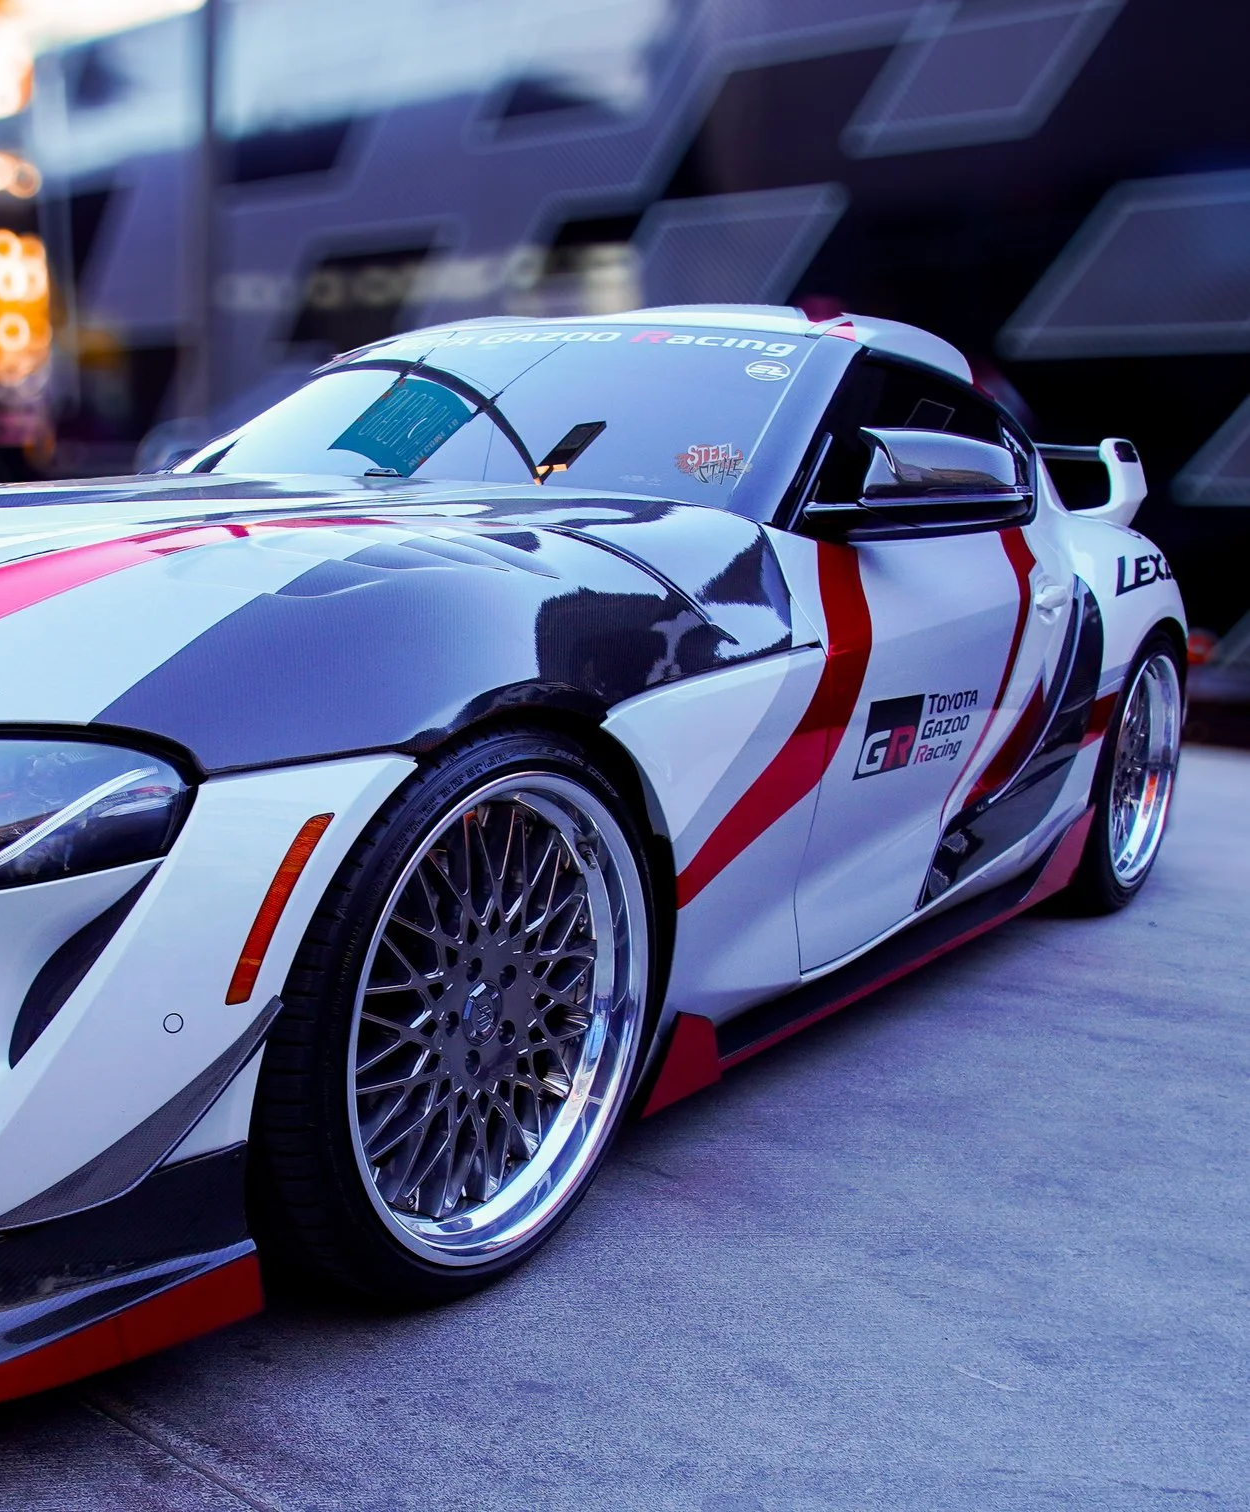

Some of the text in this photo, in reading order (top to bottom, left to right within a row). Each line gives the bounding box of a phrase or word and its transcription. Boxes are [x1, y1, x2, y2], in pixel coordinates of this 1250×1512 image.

[478, 331, 622, 344] GAZOO
[629, 330, 798, 358] Racing
[686, 443, 739, 465] STEEL
[928, 690, 978, 715] TOYOTA
[920, 714, 970, 740] GAZOO
[857, 725, 916, 775] GR
[913, 739, 962, 765] Racing
